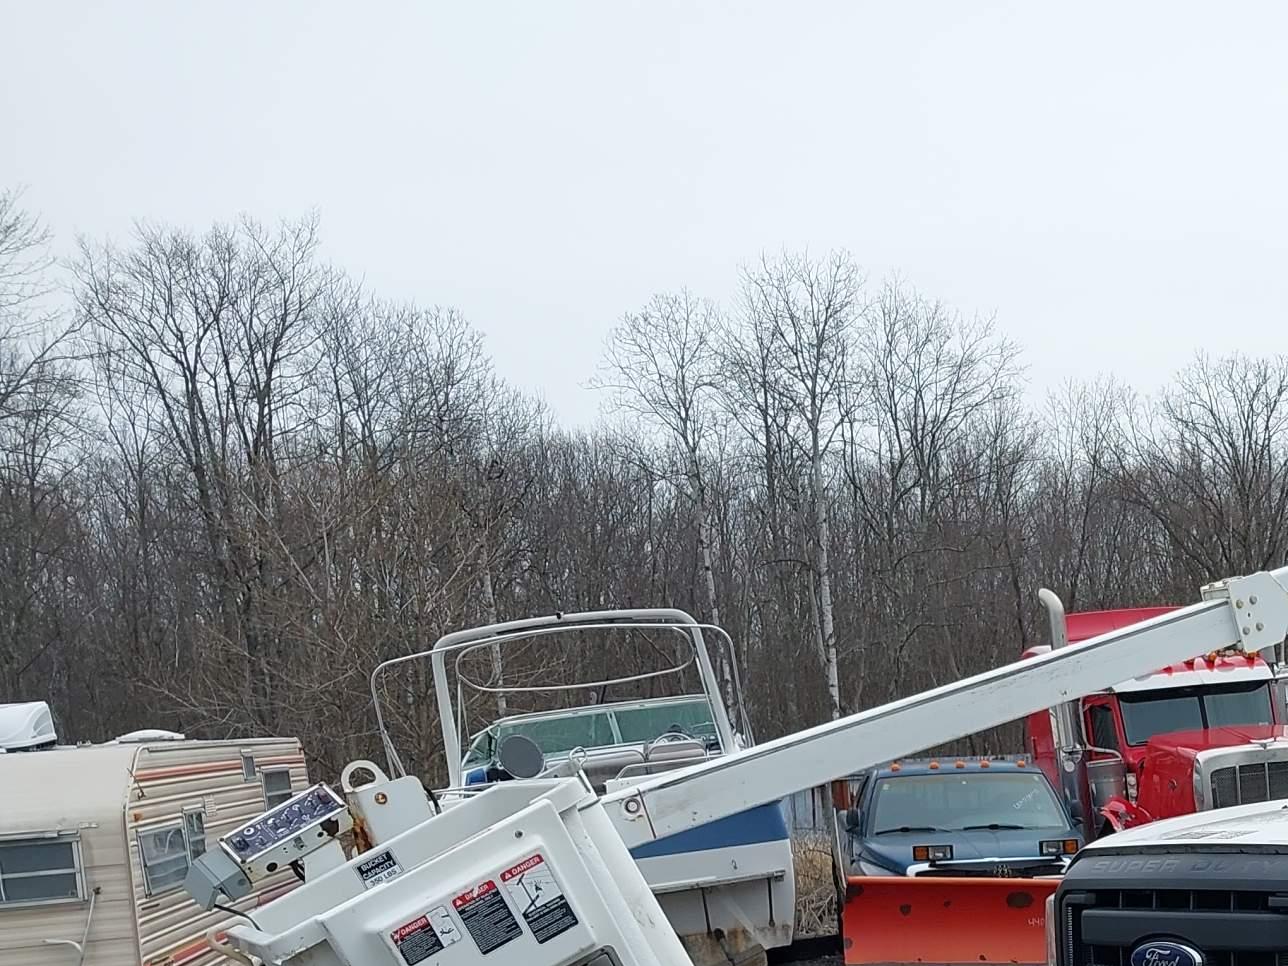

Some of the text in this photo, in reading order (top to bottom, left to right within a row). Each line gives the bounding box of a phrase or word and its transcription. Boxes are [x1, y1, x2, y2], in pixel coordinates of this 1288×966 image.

[360, 853, 388, 872] BUCKET
[362, 860, 395, 880] CAPACITY
[511, 855, 541, 875] DANGER
[1091, 858, 1281, 873] SUPER DUTY
[400, 917, 428, 936] DANGER
